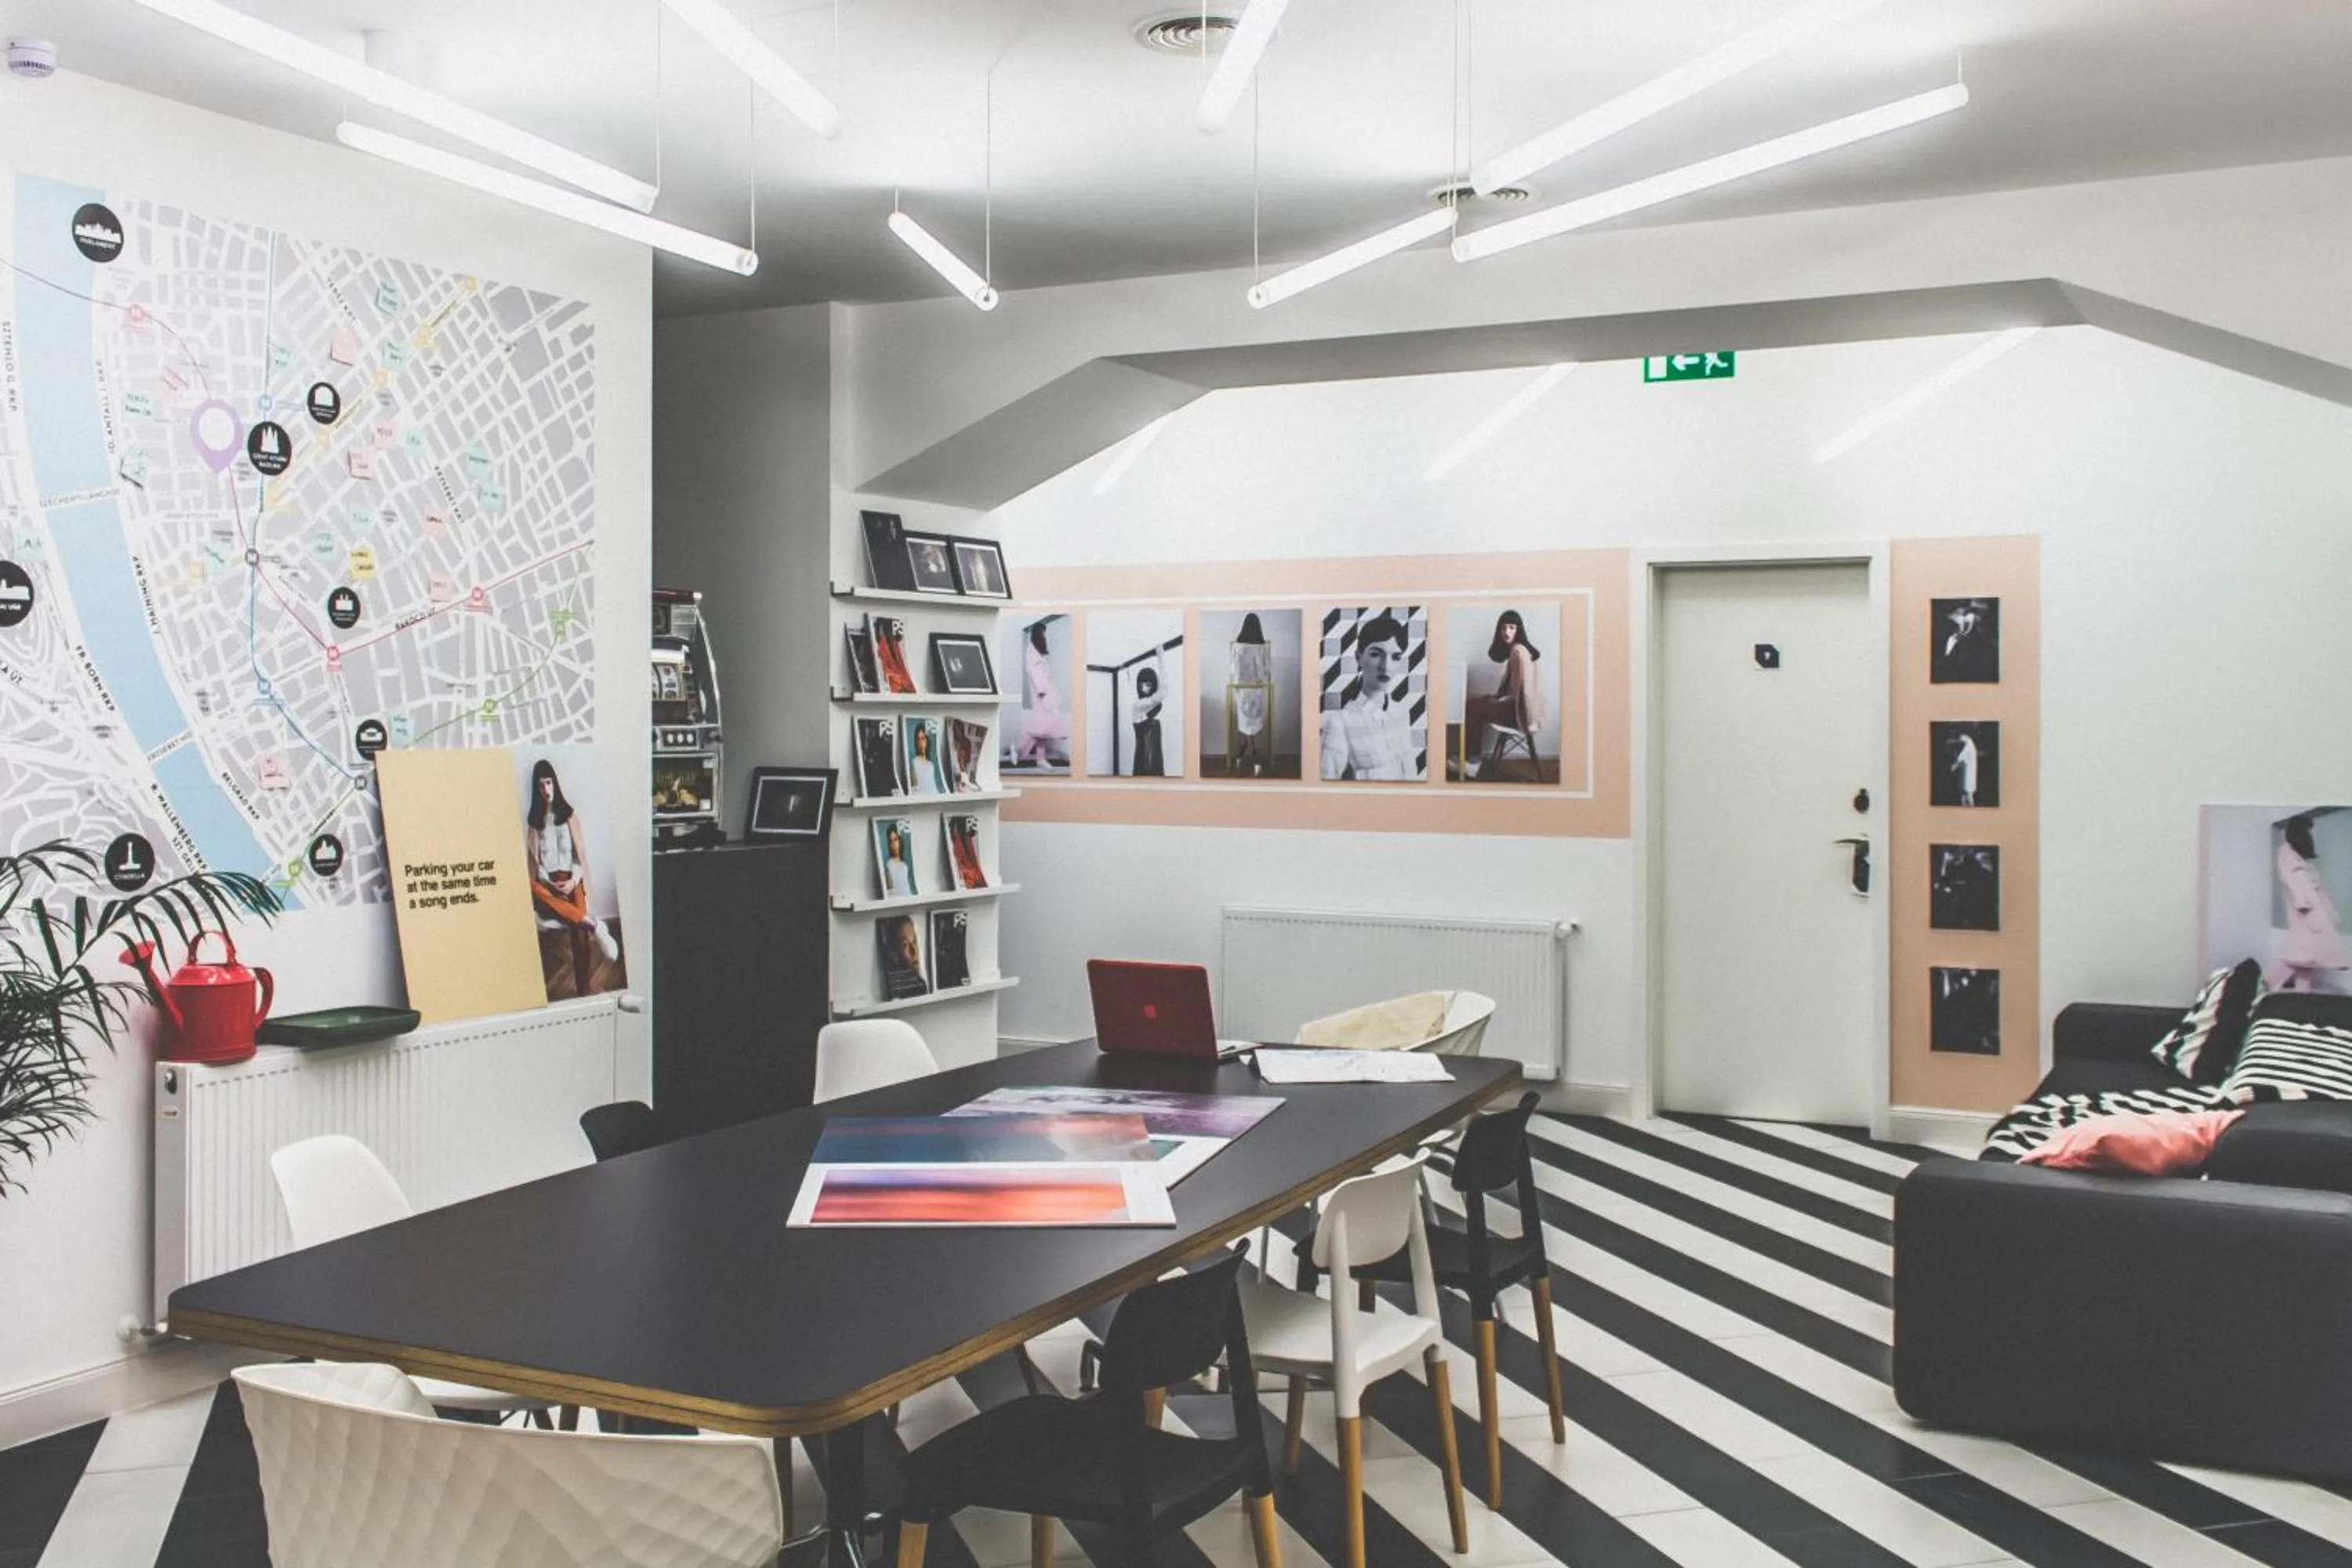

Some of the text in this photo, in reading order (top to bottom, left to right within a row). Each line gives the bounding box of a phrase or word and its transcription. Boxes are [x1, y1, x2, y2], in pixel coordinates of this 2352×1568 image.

[405, 860, 495, 877] Parking your car
[407, 874, 497, 893] at the same time
[409, 891, 481, 910] a song ends.
